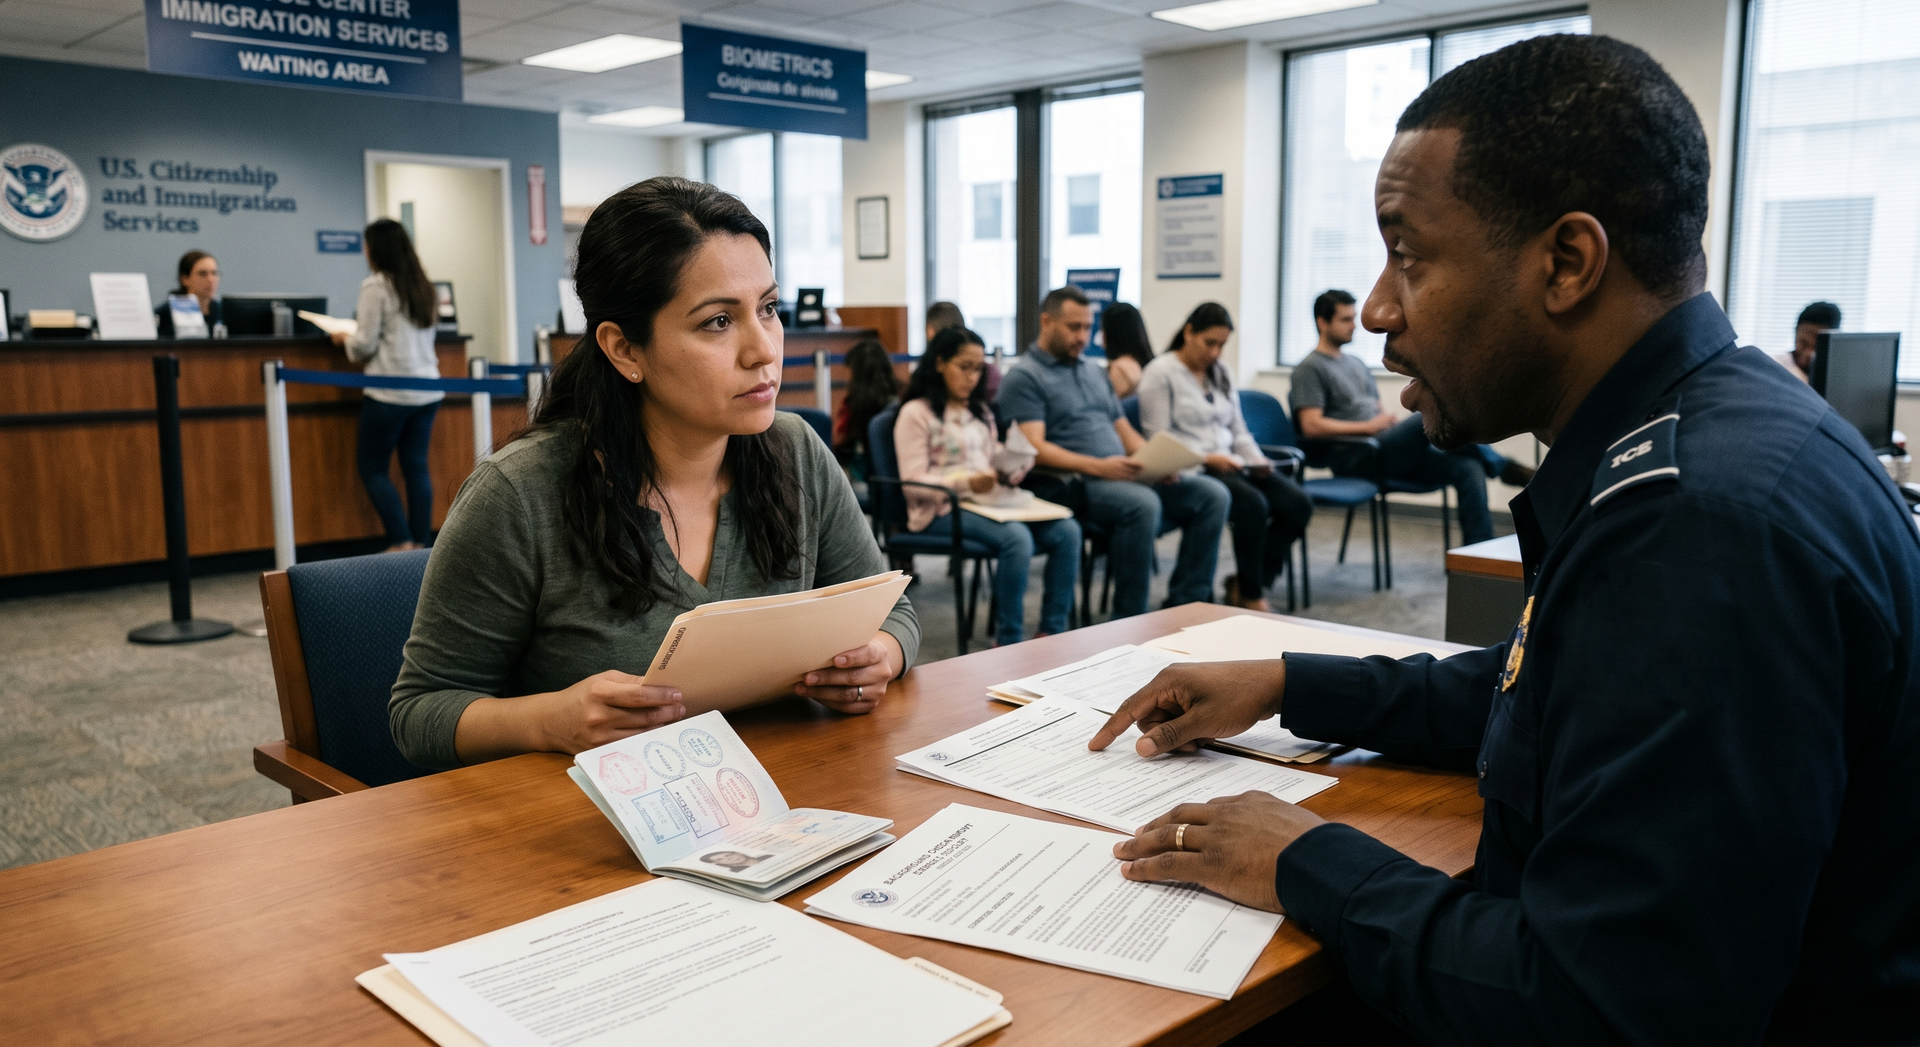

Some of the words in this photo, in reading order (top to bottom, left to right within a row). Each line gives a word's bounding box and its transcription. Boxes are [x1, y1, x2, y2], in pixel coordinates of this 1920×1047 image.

[161, 0, 331, 38] IMMIGRATION
[336, 19, 449, 52] SERVICES
[238, 50, 329, 78] WAITING
[332, 61, 390, 85] AREA
[721, 43, 834, 79] BIOMETRICS
[99, 157, 143, 179] U.S.
[150, 160, 279, 194] Citizenship
[102, 184, 147, 205] and
[155, 186, 297, 215] Immigration
[104, 210, 199, 233] Services
[1611, 440, 1653, 468] ICE
